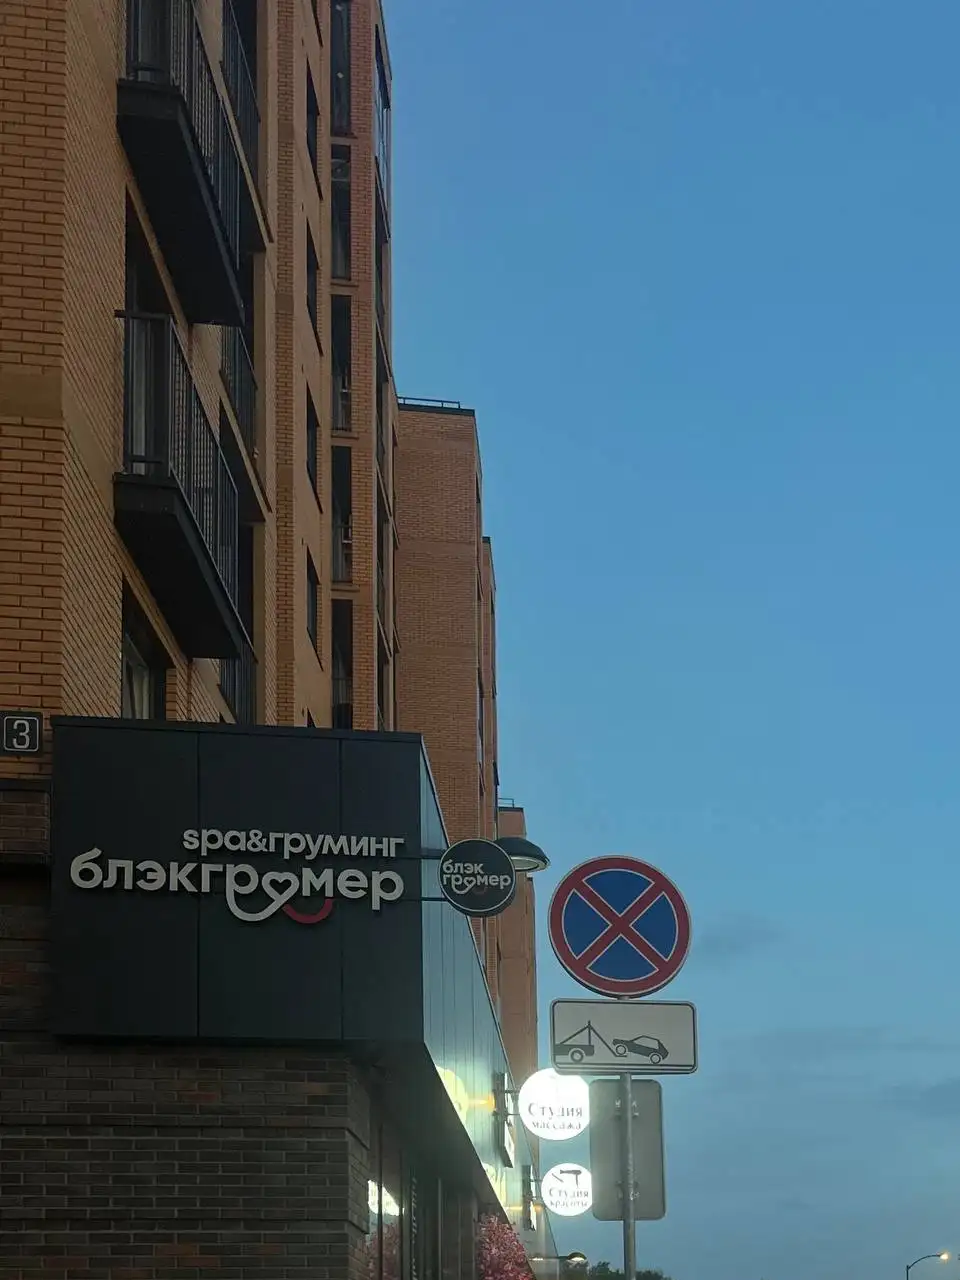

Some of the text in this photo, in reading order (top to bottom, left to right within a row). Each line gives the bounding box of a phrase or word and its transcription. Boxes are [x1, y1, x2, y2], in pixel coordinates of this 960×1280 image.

[13, 719, 30, 749] 3
[182, 828, 405, 861] spa&груминг
[442, 858, 485, 875] блэк
[527, 1102, 583, 1121] Студия
[548, 1186, 589, 1201] Студия
